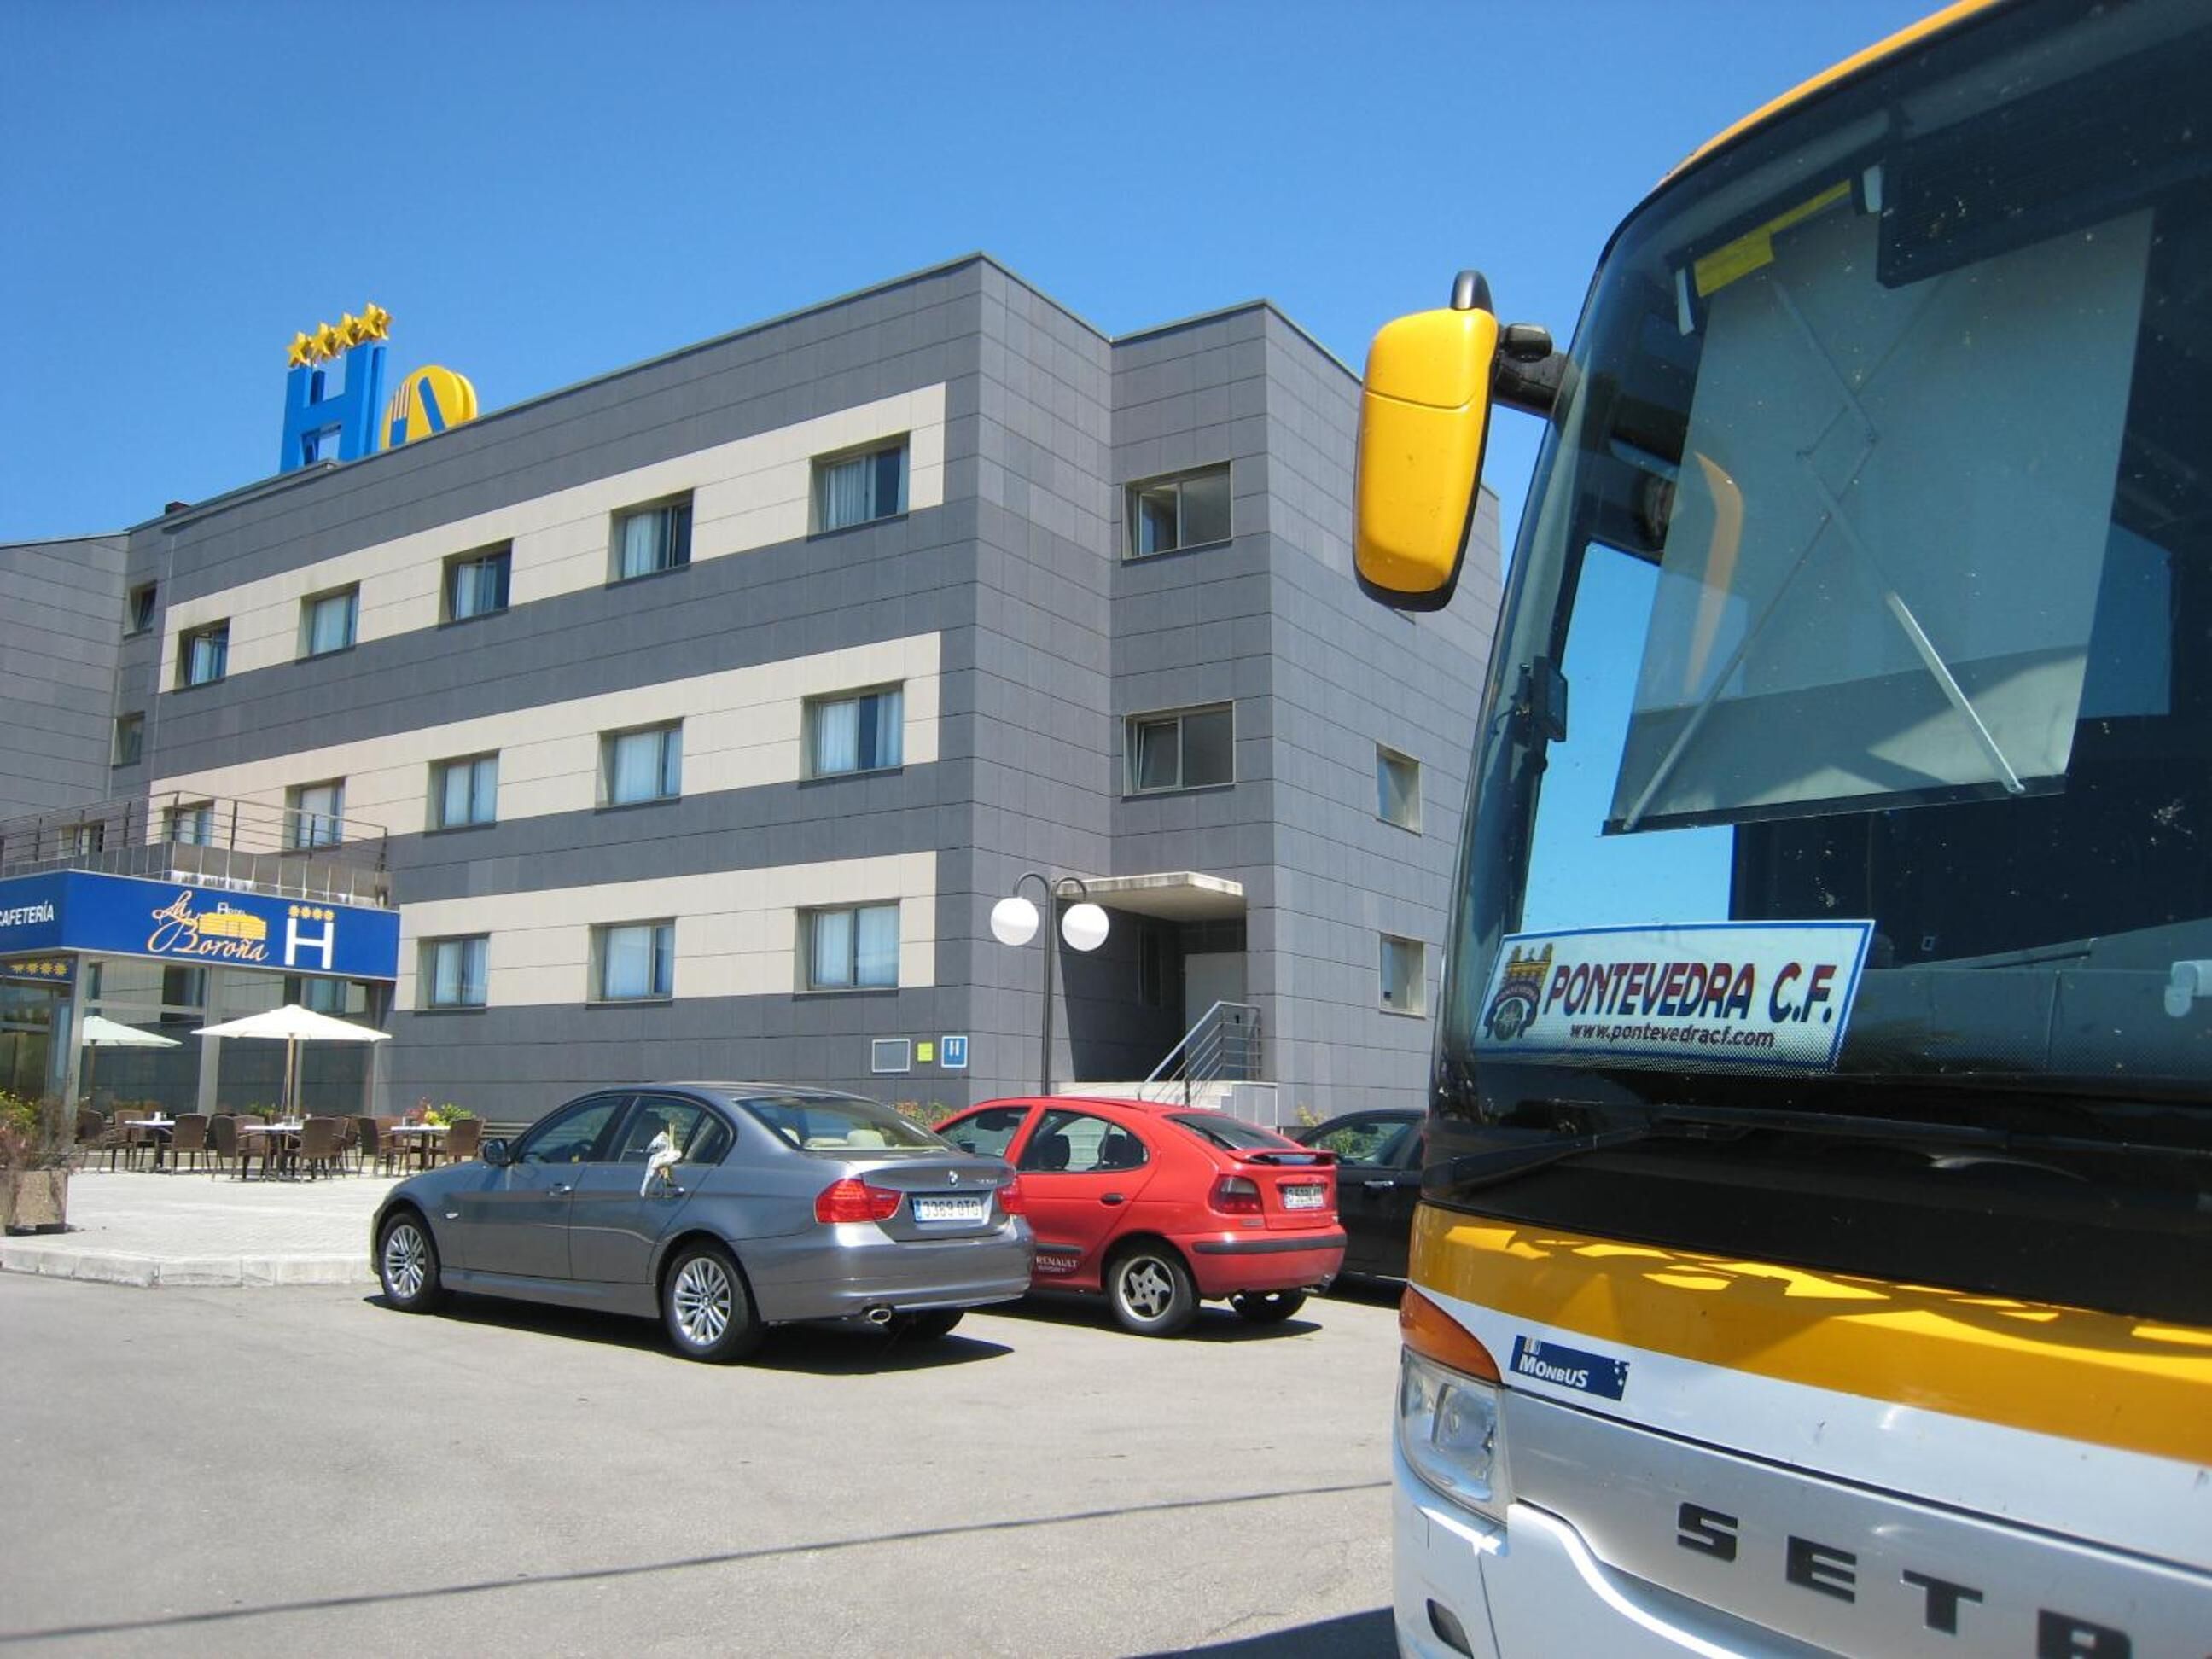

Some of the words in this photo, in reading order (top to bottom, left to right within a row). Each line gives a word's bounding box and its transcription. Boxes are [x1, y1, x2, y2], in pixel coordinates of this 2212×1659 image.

[148, 918, 269, 961] Boroña
[284, 917, 334, 969] H
[1543, 963, 1755, 1020] PONTEVEDRA
[1769, 963, 1837, 1023] C.F.
[1569, 1022, 1774, 1048] www.pontevedracf.com
[1036, 1255, 1078, 1268] RENAULT
[1677, 1501, 2212, 1659] SETR
